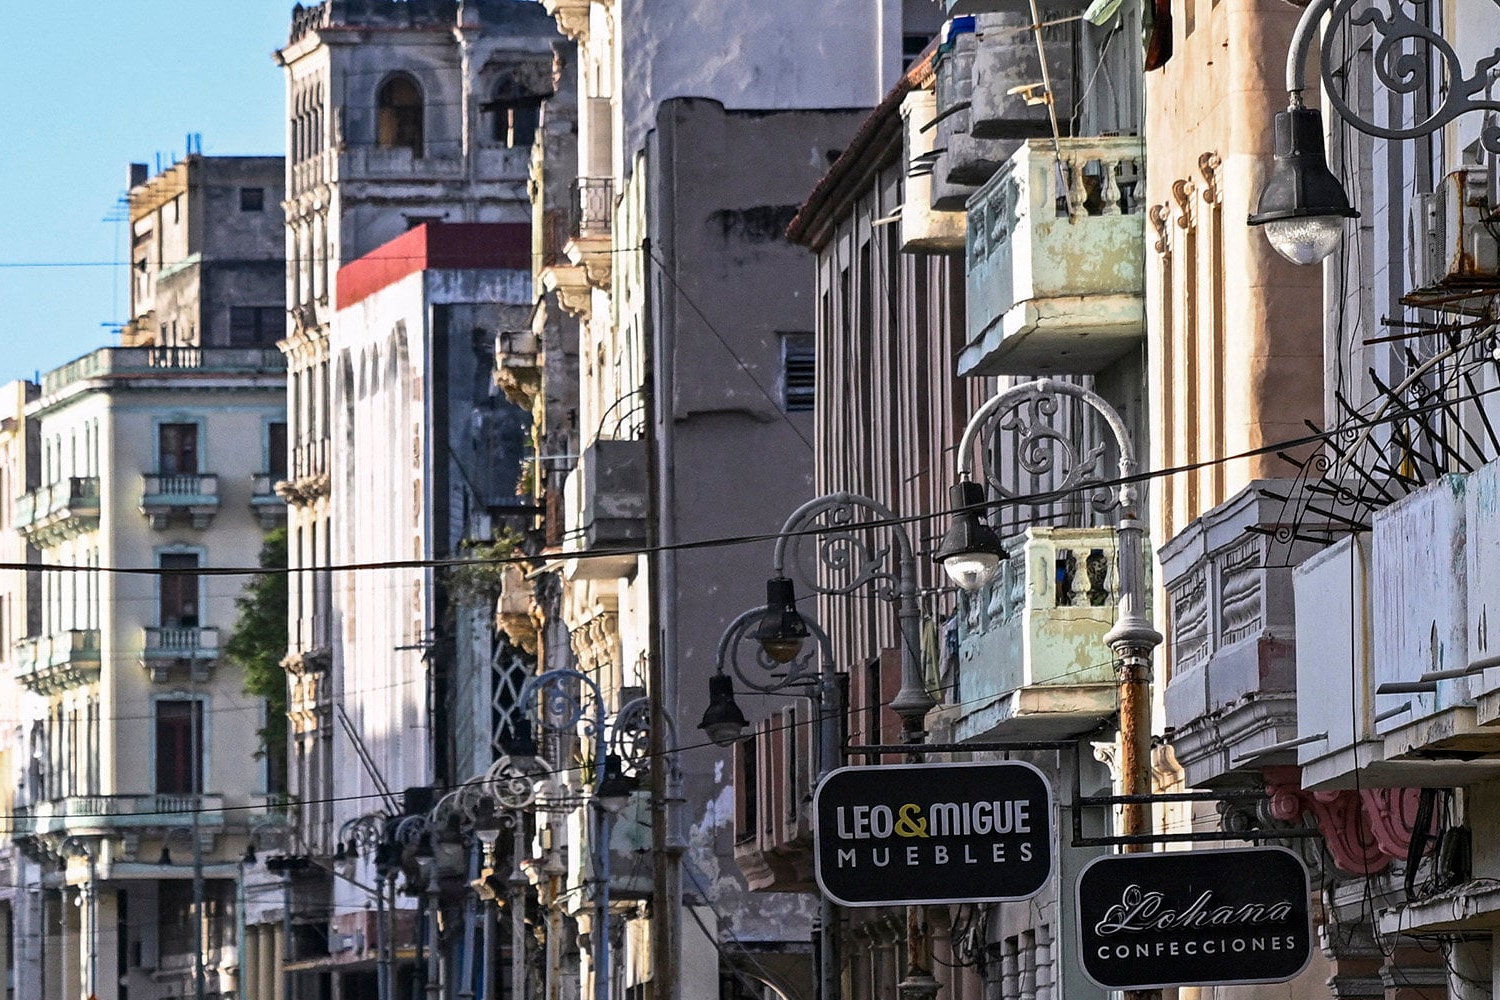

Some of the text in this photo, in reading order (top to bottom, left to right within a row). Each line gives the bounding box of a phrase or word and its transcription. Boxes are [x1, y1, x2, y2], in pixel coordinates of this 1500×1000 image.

[836, 800, 1032, 840] LEO&MIGUE
[837, 842, 1033, 869] MUEBLES
[1094, 884, 1293, 937] Lohana
[1097, 936, 1295, 960] CONFECCIONES
